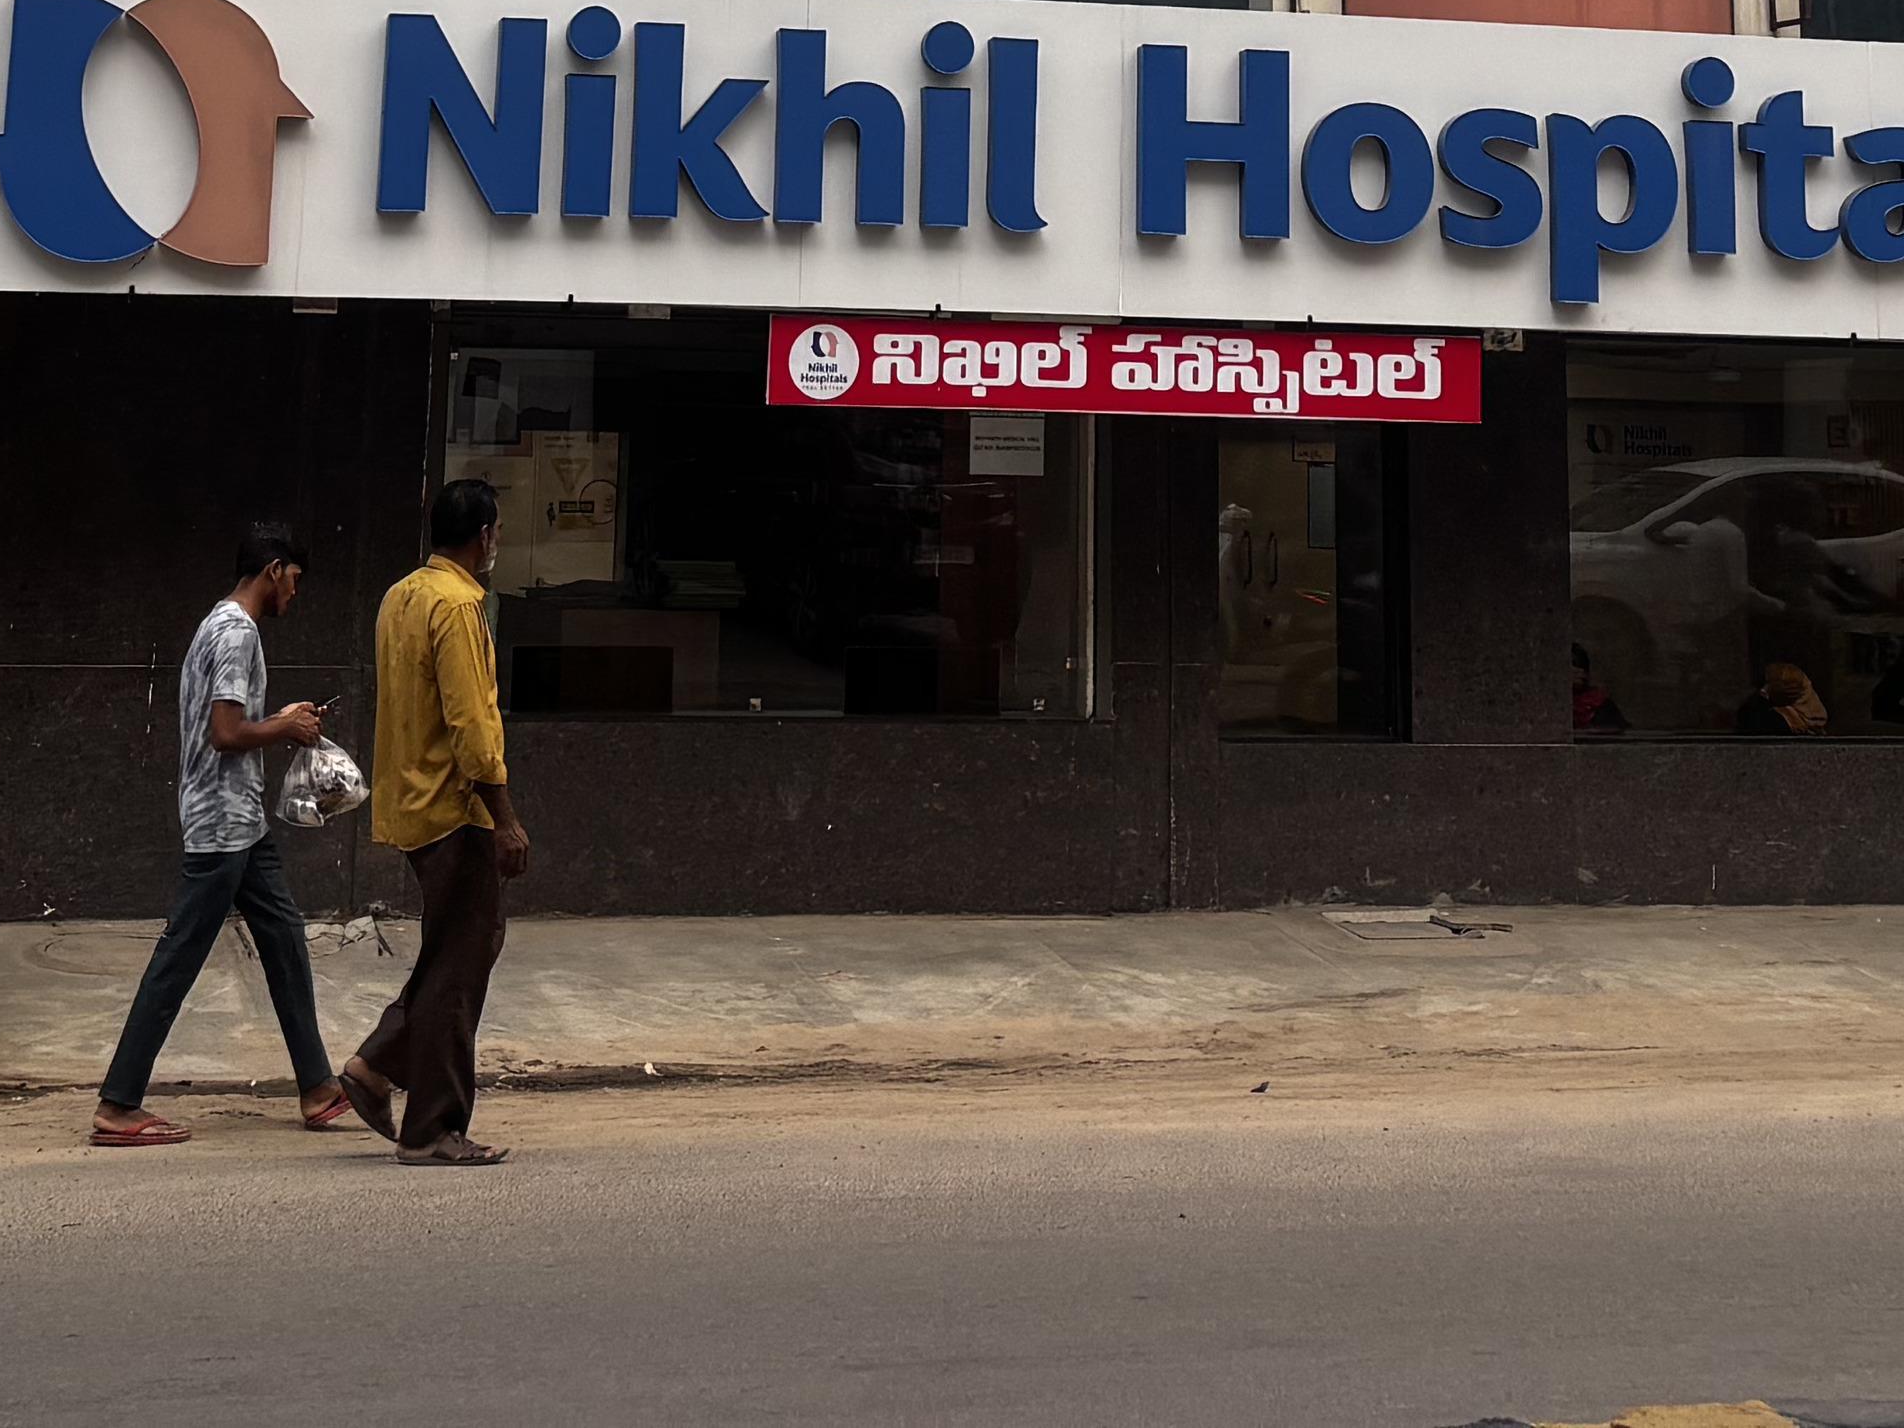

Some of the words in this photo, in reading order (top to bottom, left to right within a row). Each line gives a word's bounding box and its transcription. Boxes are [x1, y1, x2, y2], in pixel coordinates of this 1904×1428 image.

[376, 5, 1048, 233] Nikhil
[808, 362, 838, 372] Nikhil
[872, 325, 1093, 398] నిఖిల్
[1111, 333, 1446, 414] హాస్పిటల్
[800, 373, 848, 385] Hospitals
[1624, 424, 1666, 441] Nikhil
[1624, 440, 1693, 459] Hospitals
